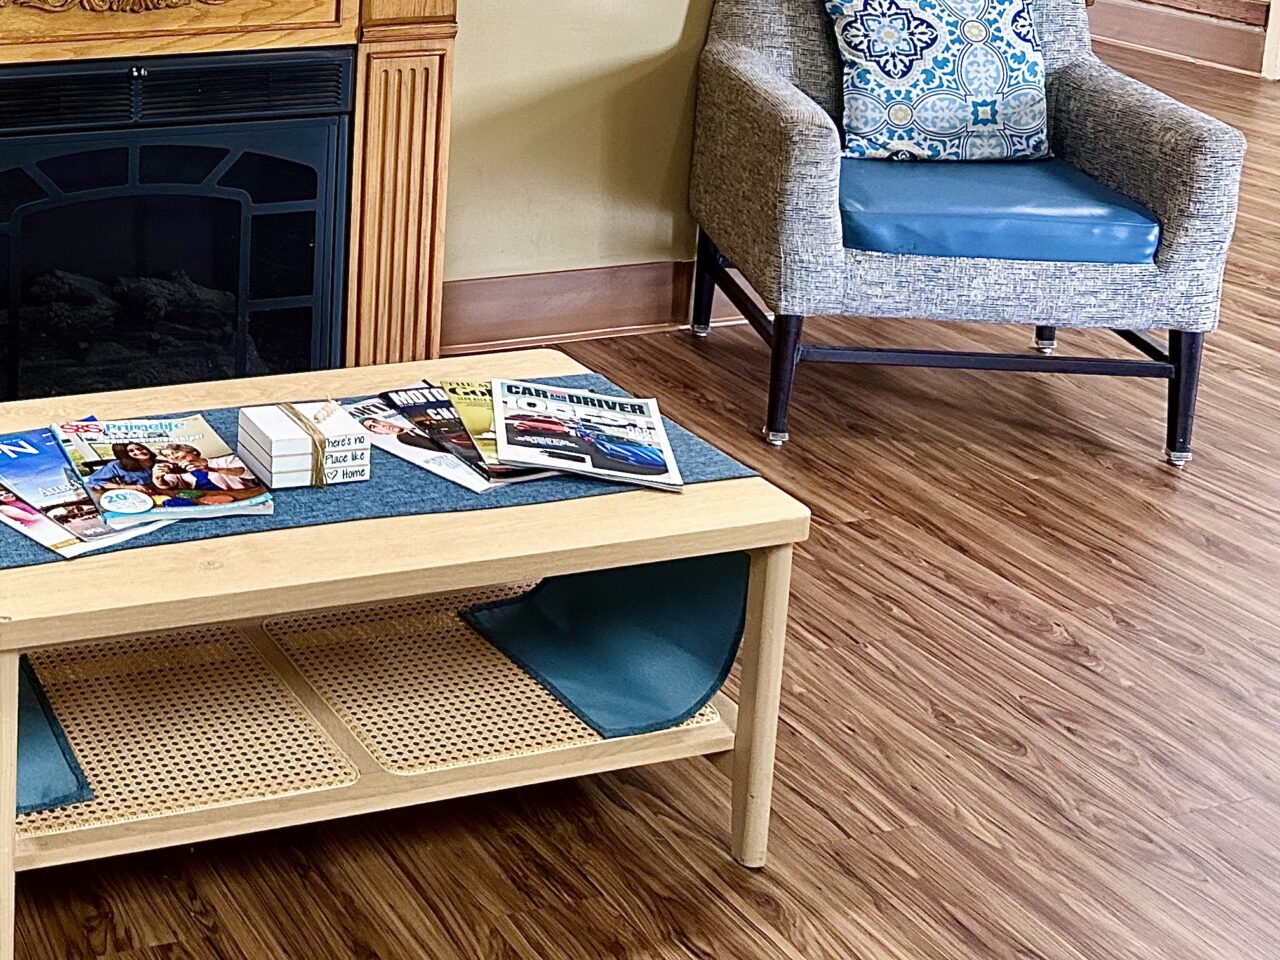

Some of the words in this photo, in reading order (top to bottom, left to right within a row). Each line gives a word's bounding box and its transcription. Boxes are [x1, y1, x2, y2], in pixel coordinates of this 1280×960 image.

[388, 388, 450, 406] MOTO
[506, 384, 549, 399] CAR
[567, 394, 646, 415] DRIVER
[354, 436, 365, 444] no
[325, 454, 348, 465] Place
[342, 468, 366, 480] Home
